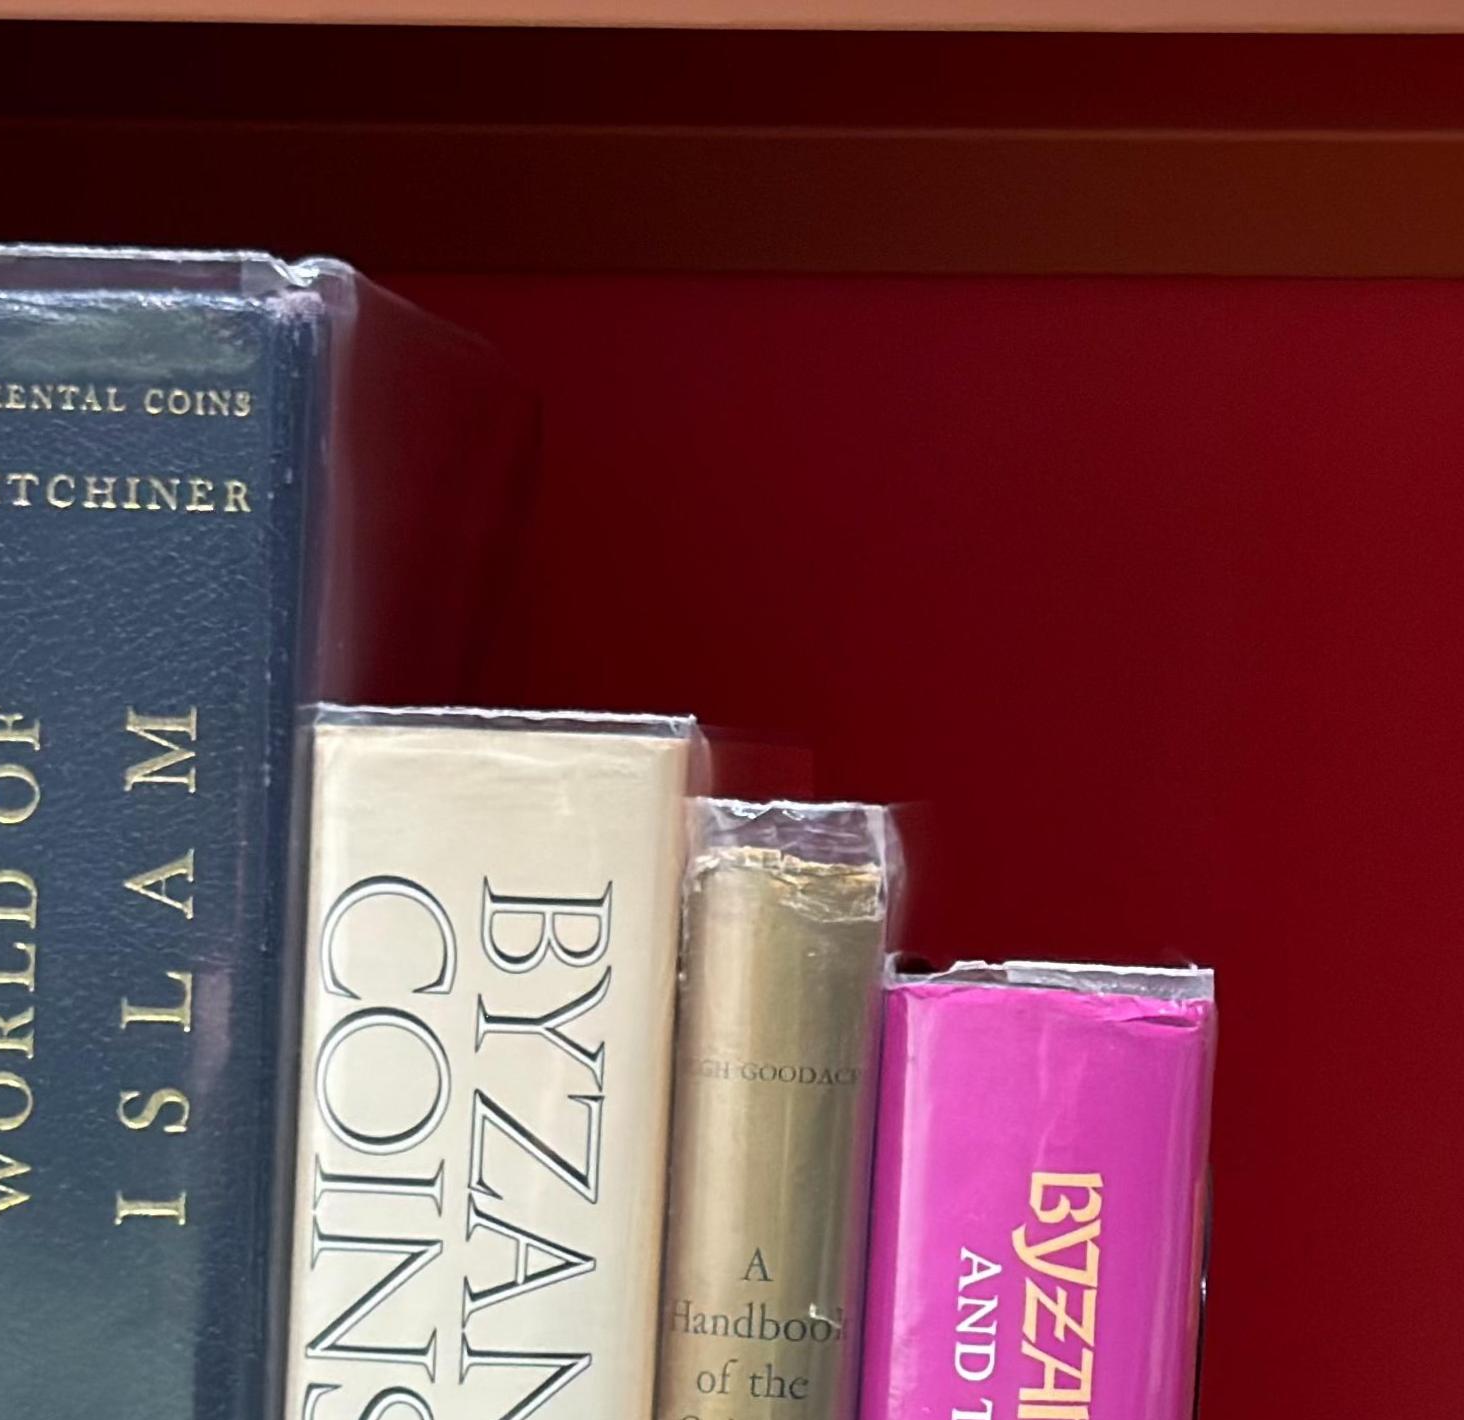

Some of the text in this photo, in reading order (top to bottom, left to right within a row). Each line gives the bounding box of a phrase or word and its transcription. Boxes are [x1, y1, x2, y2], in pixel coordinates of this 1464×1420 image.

[143, 388, 252, 417] COINS
[114, 705, 198, 1226] ISLAM
[740, 1061, 862, 1086] GOODAC
[740, 1247, 774, 1283] A
[953, 1246, 1004, 1385] AND
[696, 1359, 810, 1400] of the
